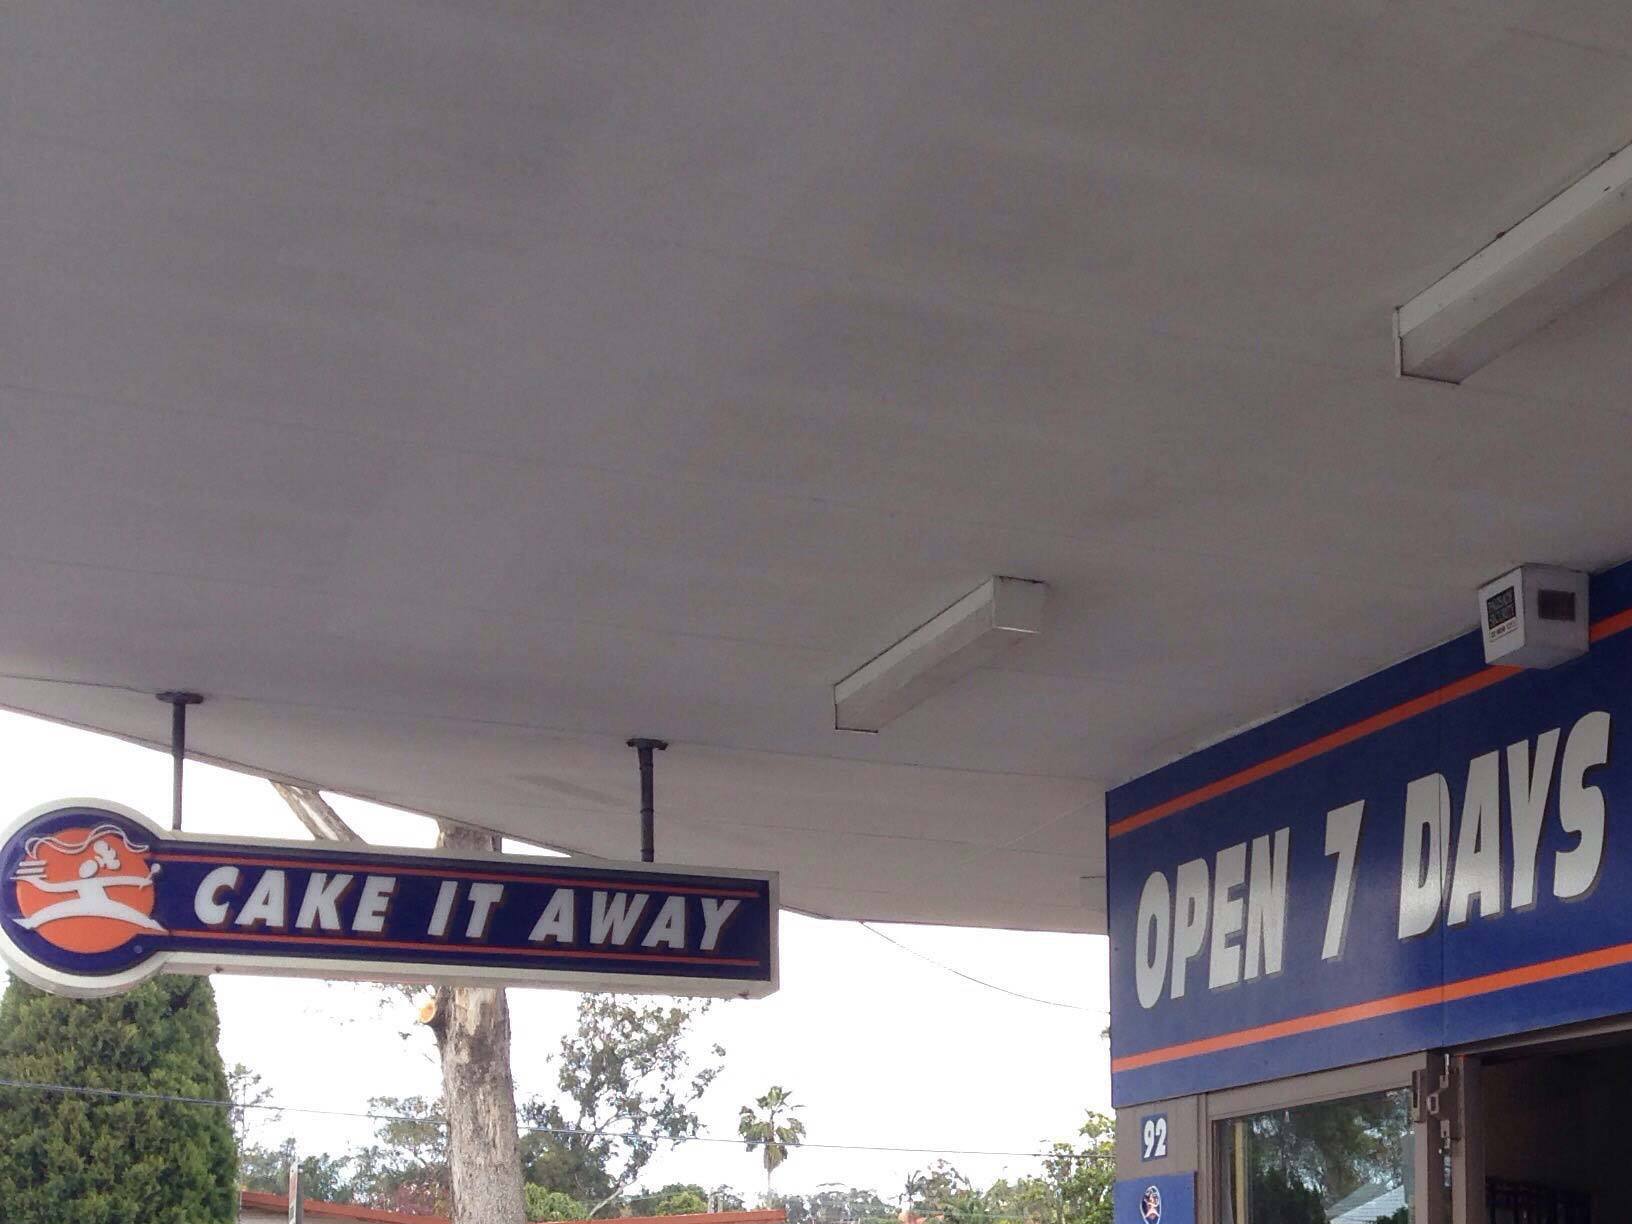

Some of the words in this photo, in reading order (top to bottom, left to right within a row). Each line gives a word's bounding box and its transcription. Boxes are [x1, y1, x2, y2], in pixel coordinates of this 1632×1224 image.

[1135, 826, 1290, 1010] OPEN
[1321, 799, 1366, 961] 7
[1397, 710, 1612, 941] DAYS
[193, 864, 396, 934] CAKE
[427, 880, 505, 940] IT
[528, 888, 742, 952] AWAY
[1143, 1117, 1168, 1160] 92
